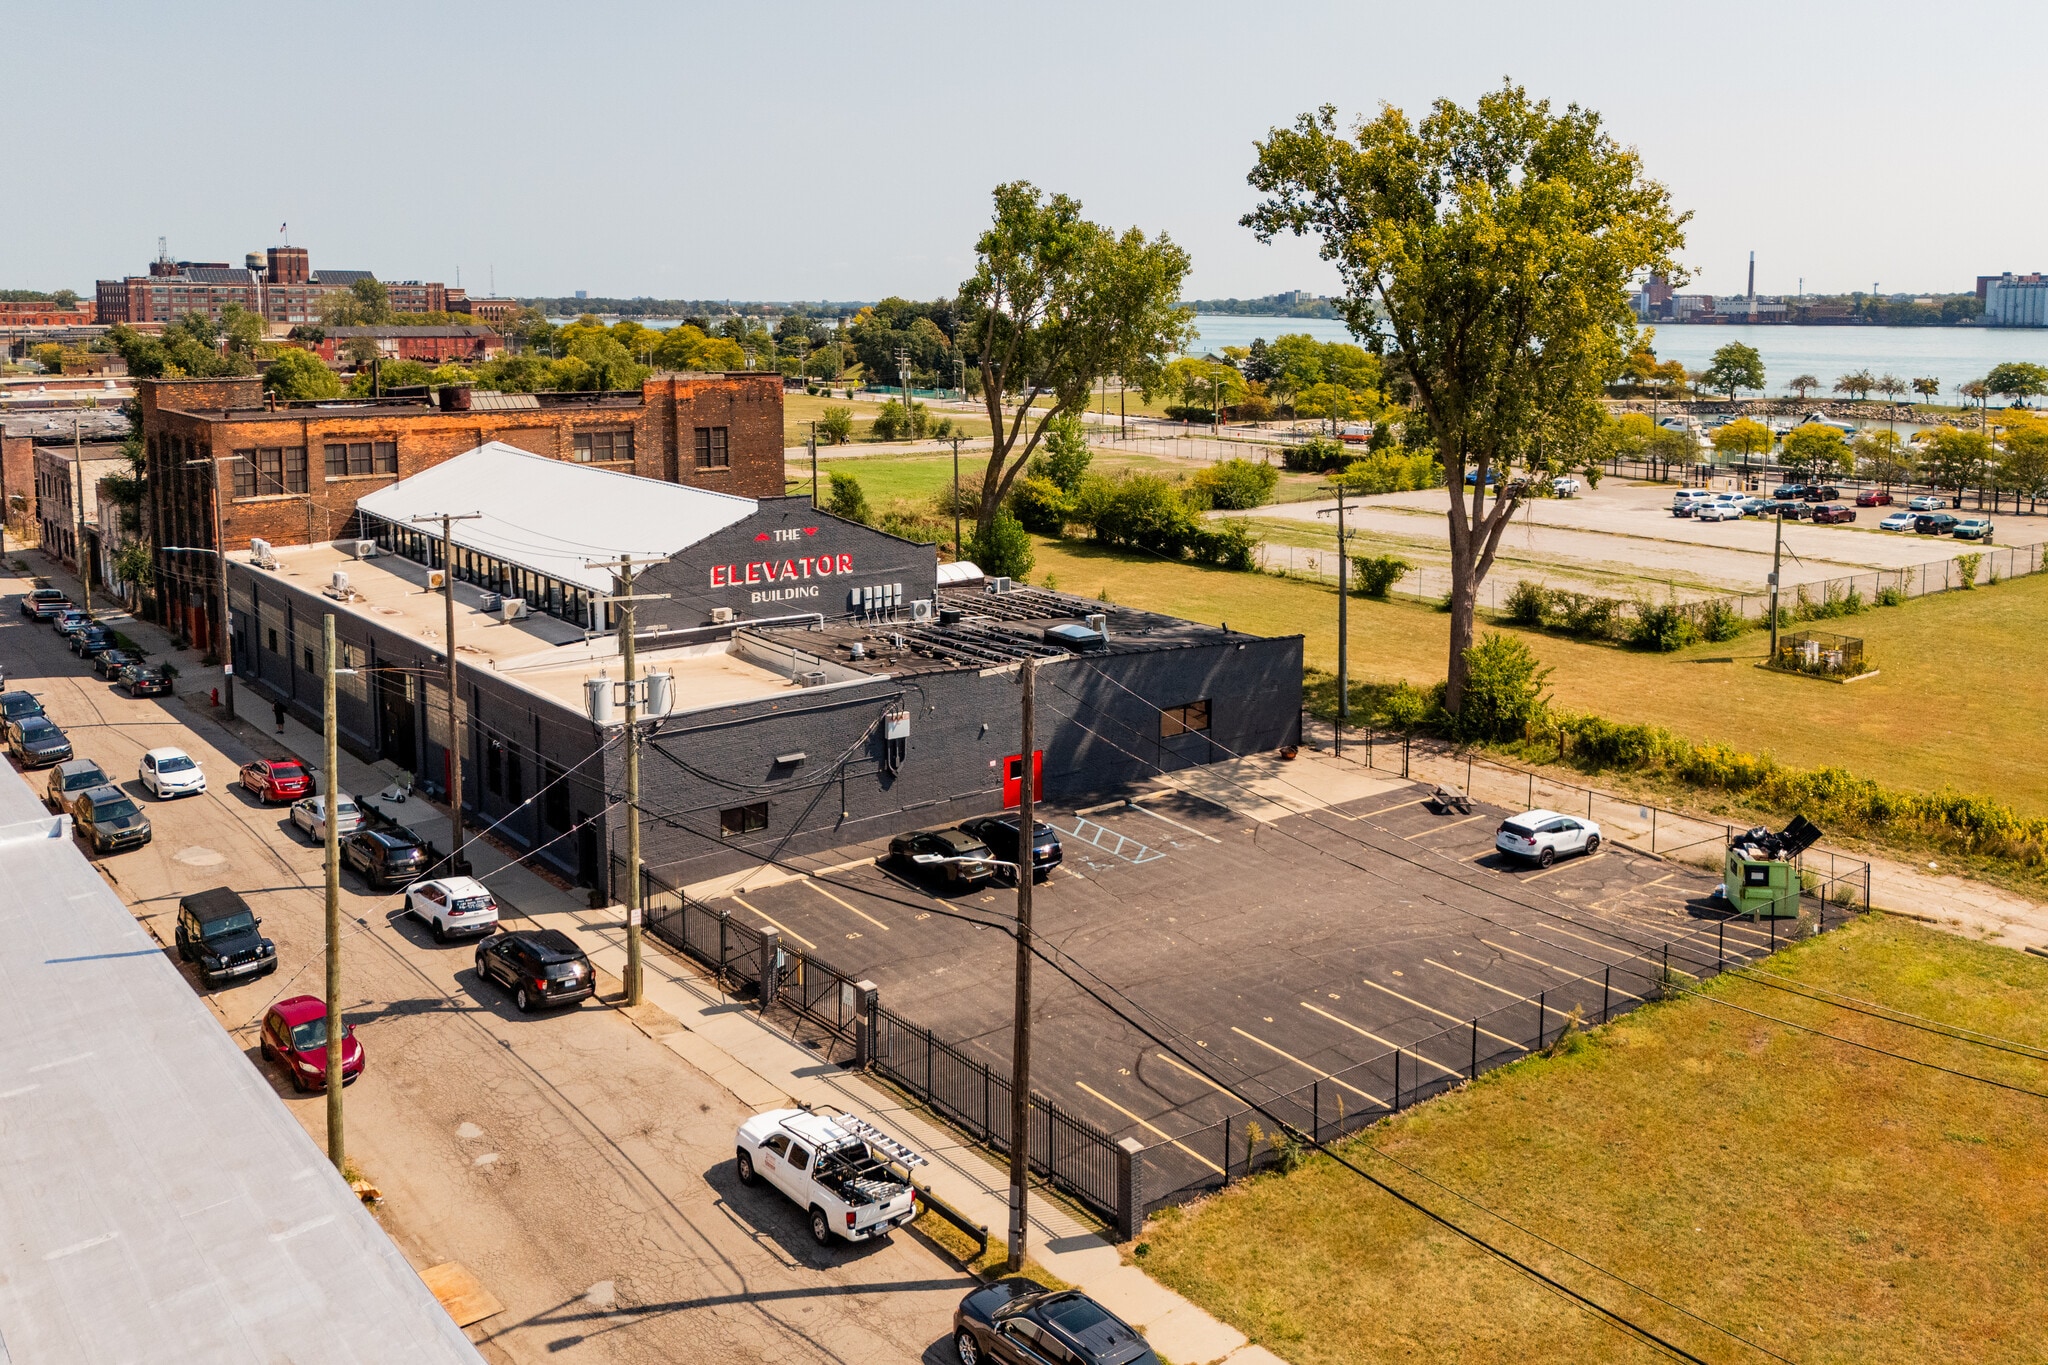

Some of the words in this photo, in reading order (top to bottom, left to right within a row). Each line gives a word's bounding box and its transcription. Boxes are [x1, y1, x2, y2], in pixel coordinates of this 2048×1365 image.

[773, 528, 801, 542] THE
[710, 553, 854, 588] ELEVATOR
[751, 586, 819, 604] BUILDING
[914, 912, 931, 921] 20
[845, 931, 864, 940] 21
